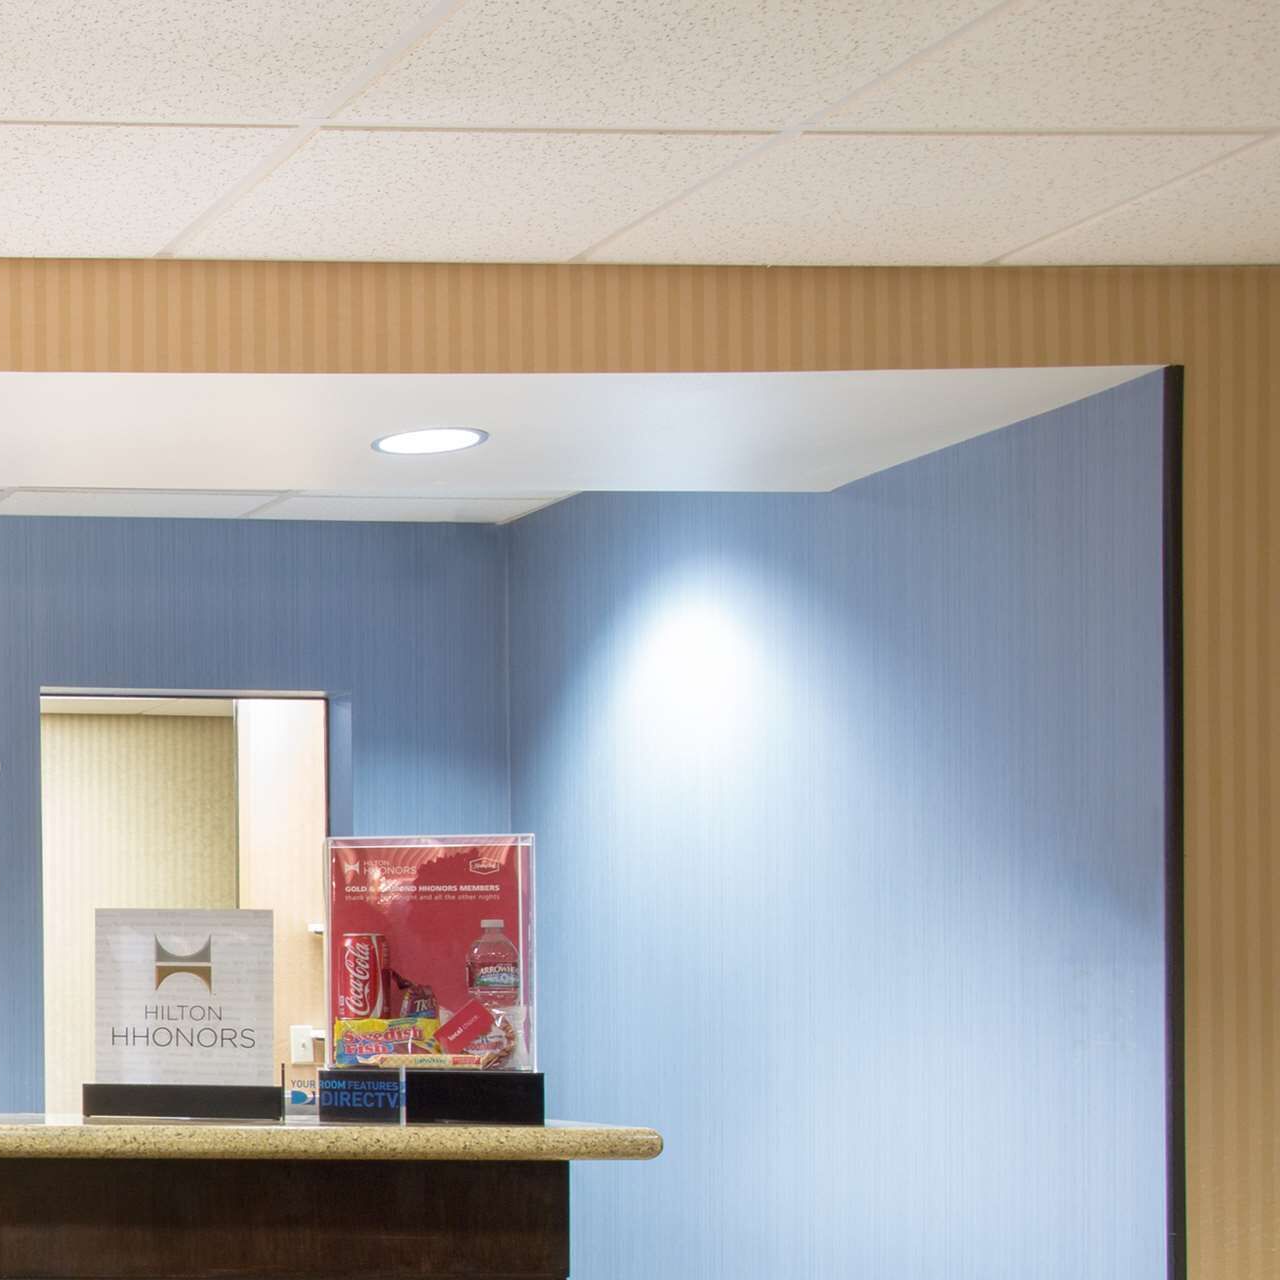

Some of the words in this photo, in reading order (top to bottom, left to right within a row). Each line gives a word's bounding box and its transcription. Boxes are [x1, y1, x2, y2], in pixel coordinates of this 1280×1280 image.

[344, 885, 368, 893] GOLD
[419, 885, 458, 893] HHONORS
[459, 884, 501, 893] MEMBERS
[144, 1005, 223, 1021] HILTON
[111, 1026, 256, 1049] HHONORS
[290, 1079, 316, 1089] YOUR
[317, 1079, 346, 1089] ROOM
[347, 1080, 399, 1091] FEATURES
[321, 1091, 400, 1109] DIRECTV
